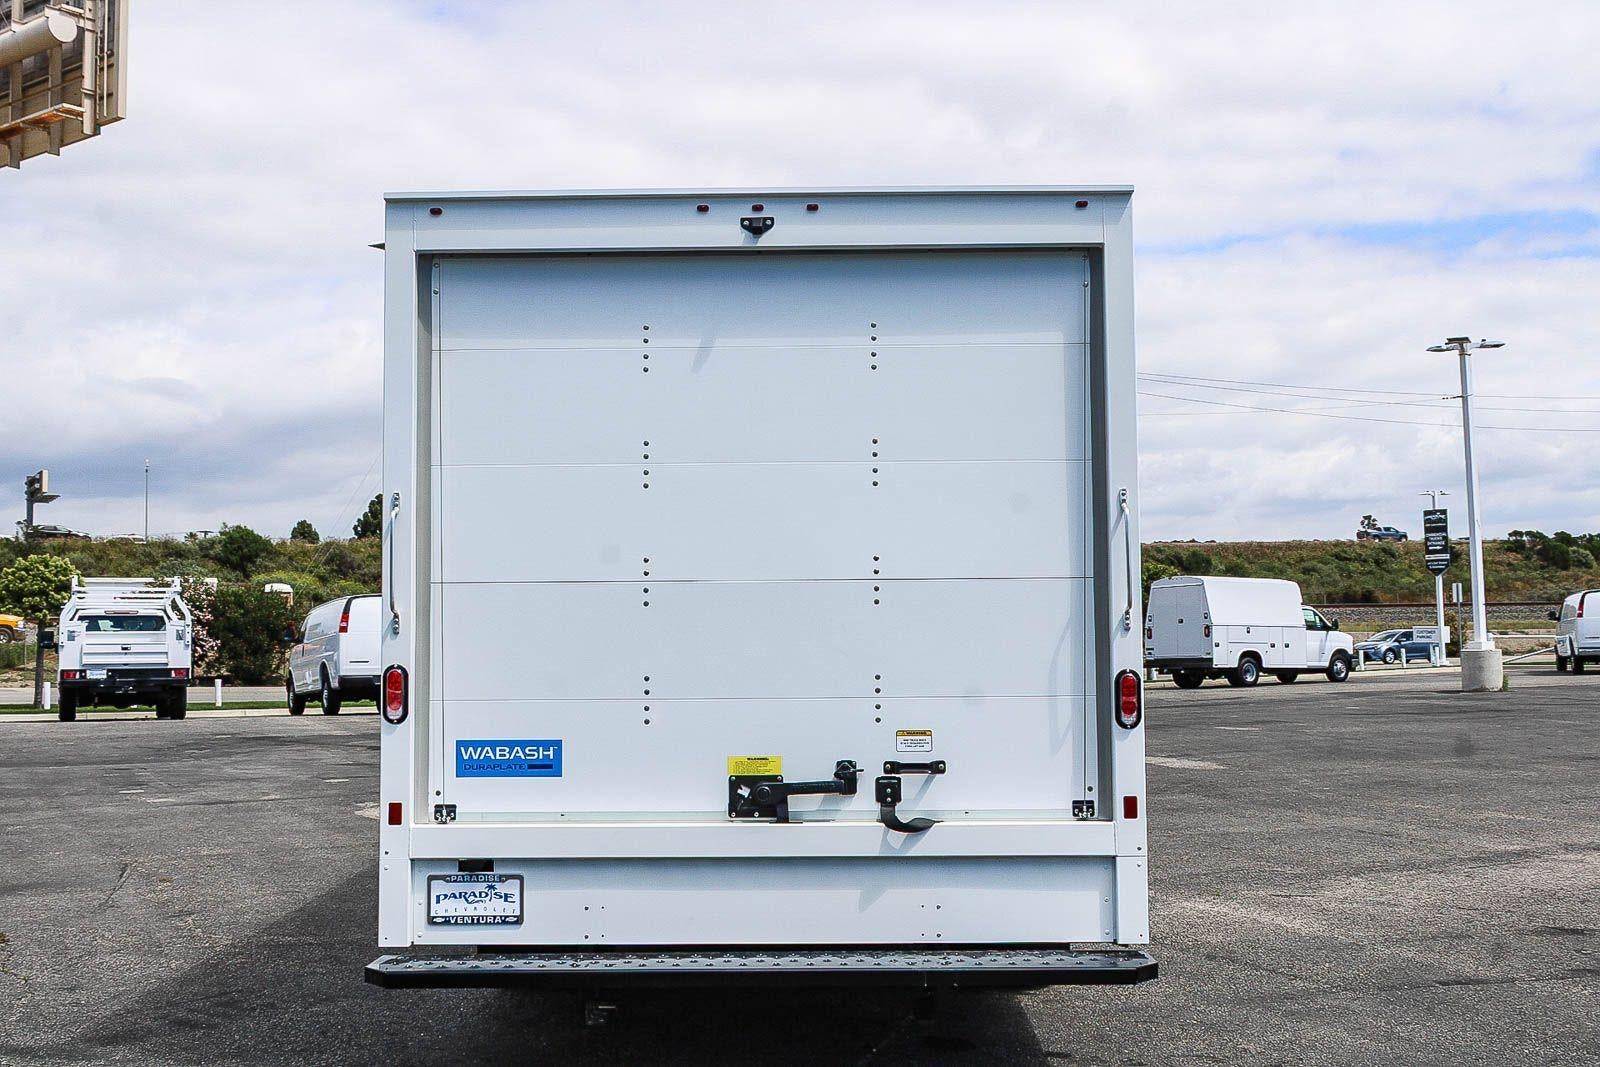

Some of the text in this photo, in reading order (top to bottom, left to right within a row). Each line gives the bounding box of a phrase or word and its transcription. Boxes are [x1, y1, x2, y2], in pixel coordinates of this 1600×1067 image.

[460, 746, 555, 760] WABASH
[463, 763, 526, 771] DURAPLATE
[450, 874, 500, 882] PARADISE
[435, 889, 516, 904] PARADISE
[434, 906, 516, 915] CHEVROLET
[449, 916, 502, 924] VENTURA
